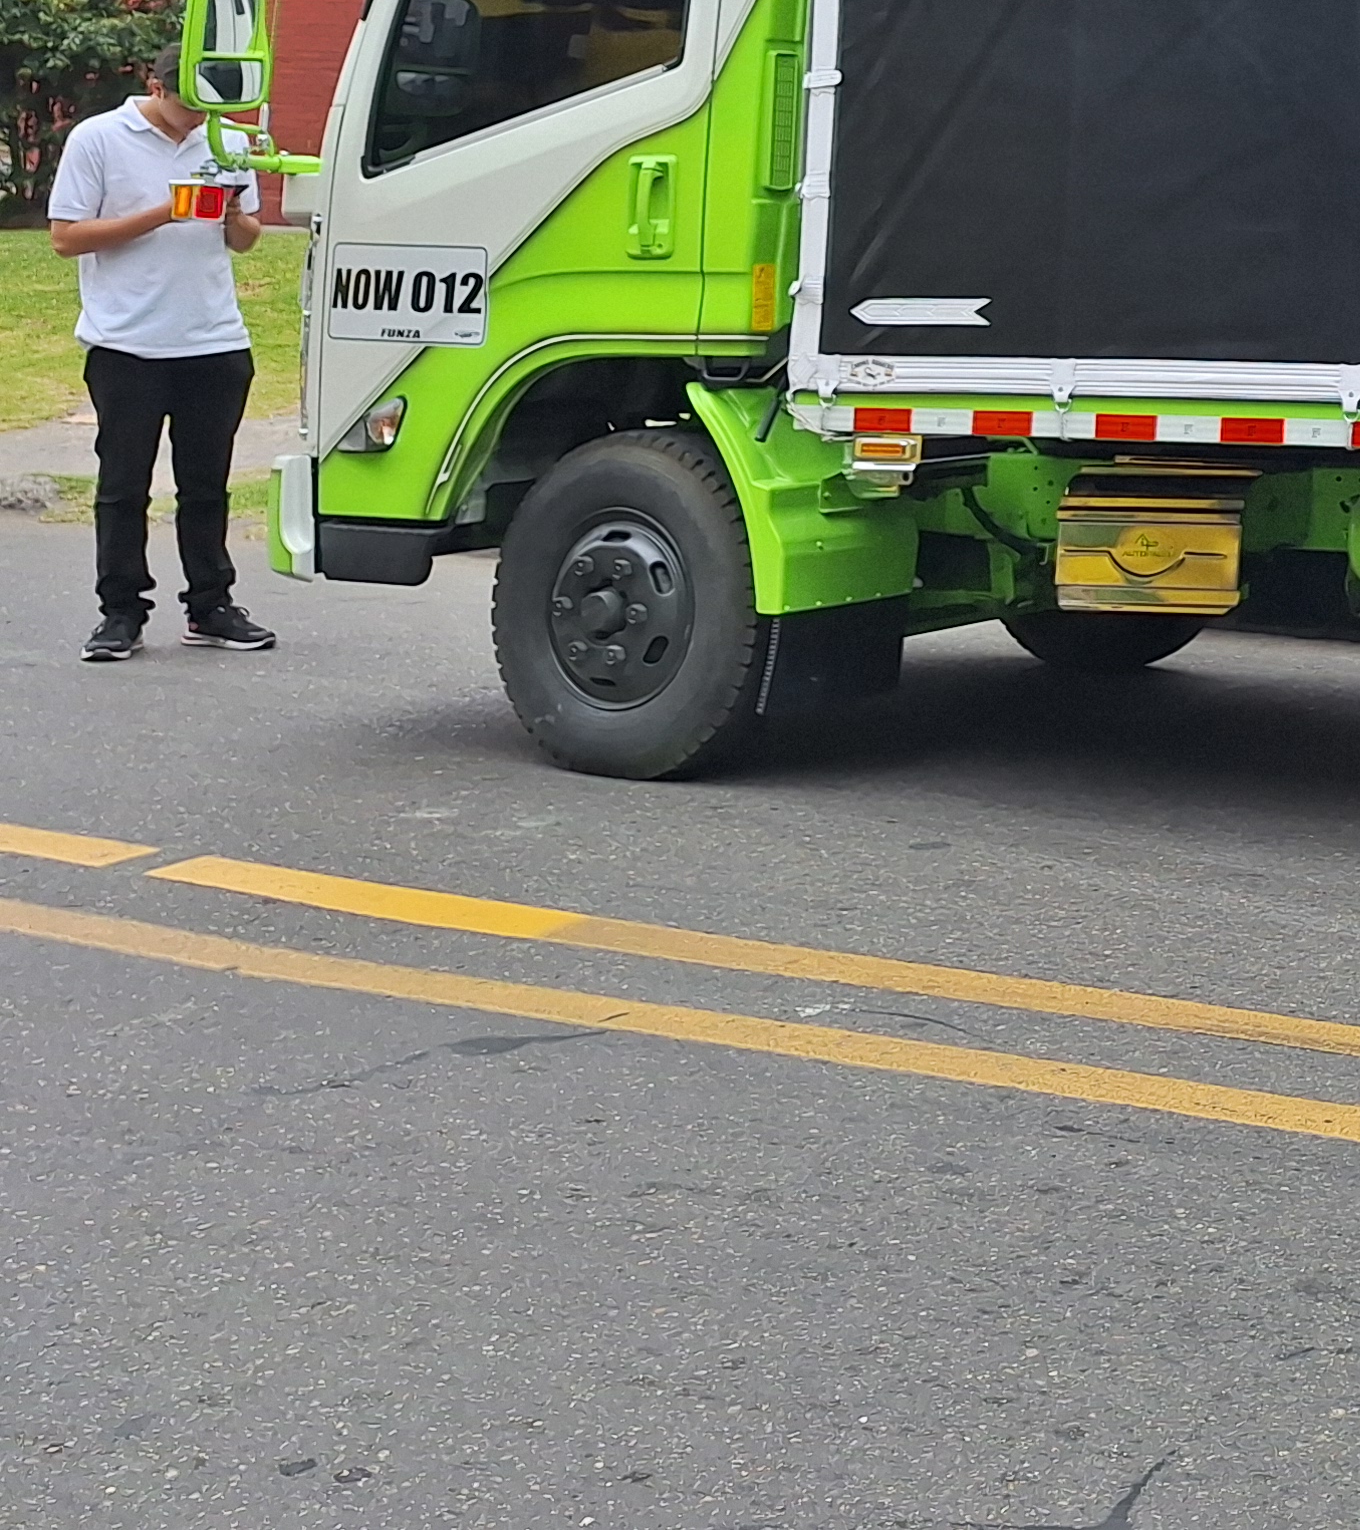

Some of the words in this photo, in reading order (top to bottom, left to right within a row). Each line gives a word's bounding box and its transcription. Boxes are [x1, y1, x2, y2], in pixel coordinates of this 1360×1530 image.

[332, 268, 405, 312] NOW
[411, 270, 484, 314] 012
[380, 327, 421, 338] FUNZA
